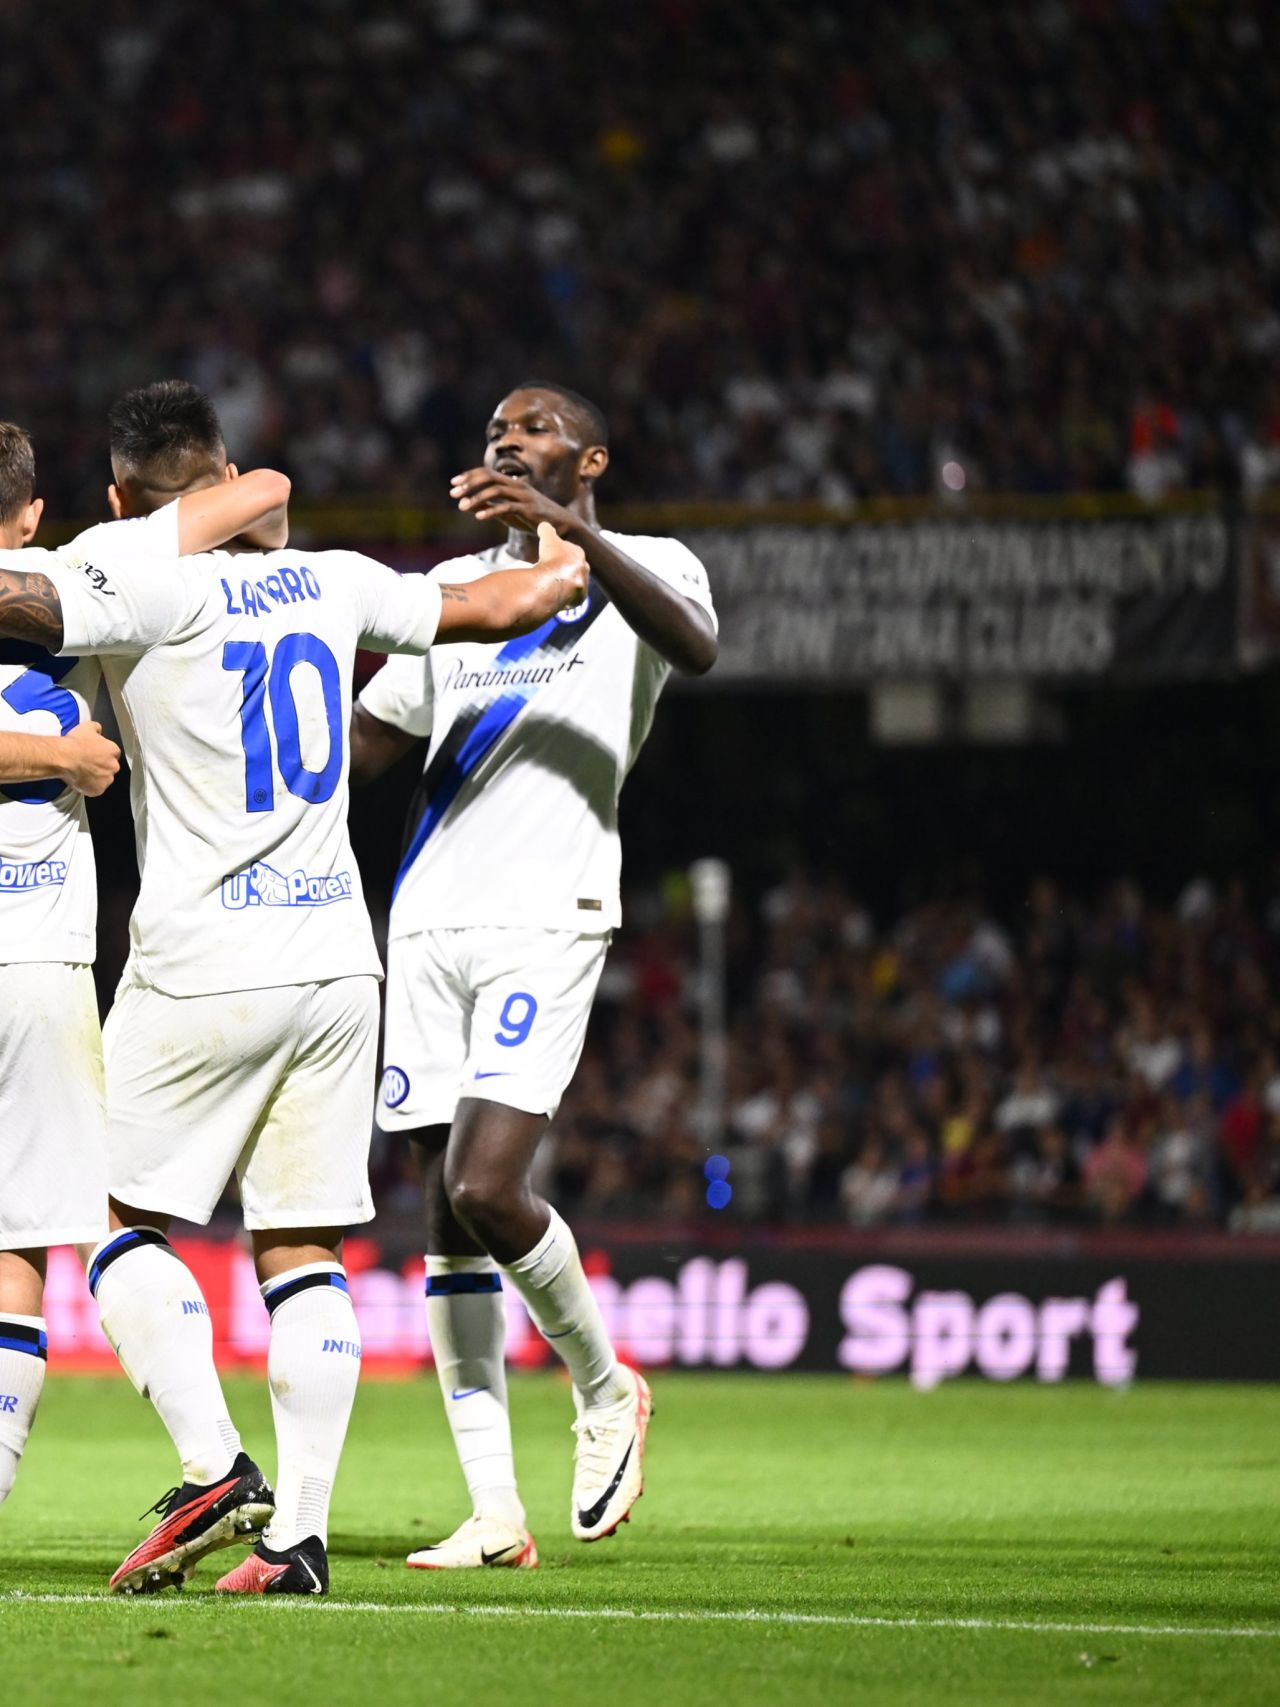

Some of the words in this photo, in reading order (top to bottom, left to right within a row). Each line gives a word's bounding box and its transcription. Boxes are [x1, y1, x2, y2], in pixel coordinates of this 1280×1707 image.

[222, 632, 342, 812] 10
[494, 992, 537, 1047] 9
[838, 1263, 1139, 1391] Sport
